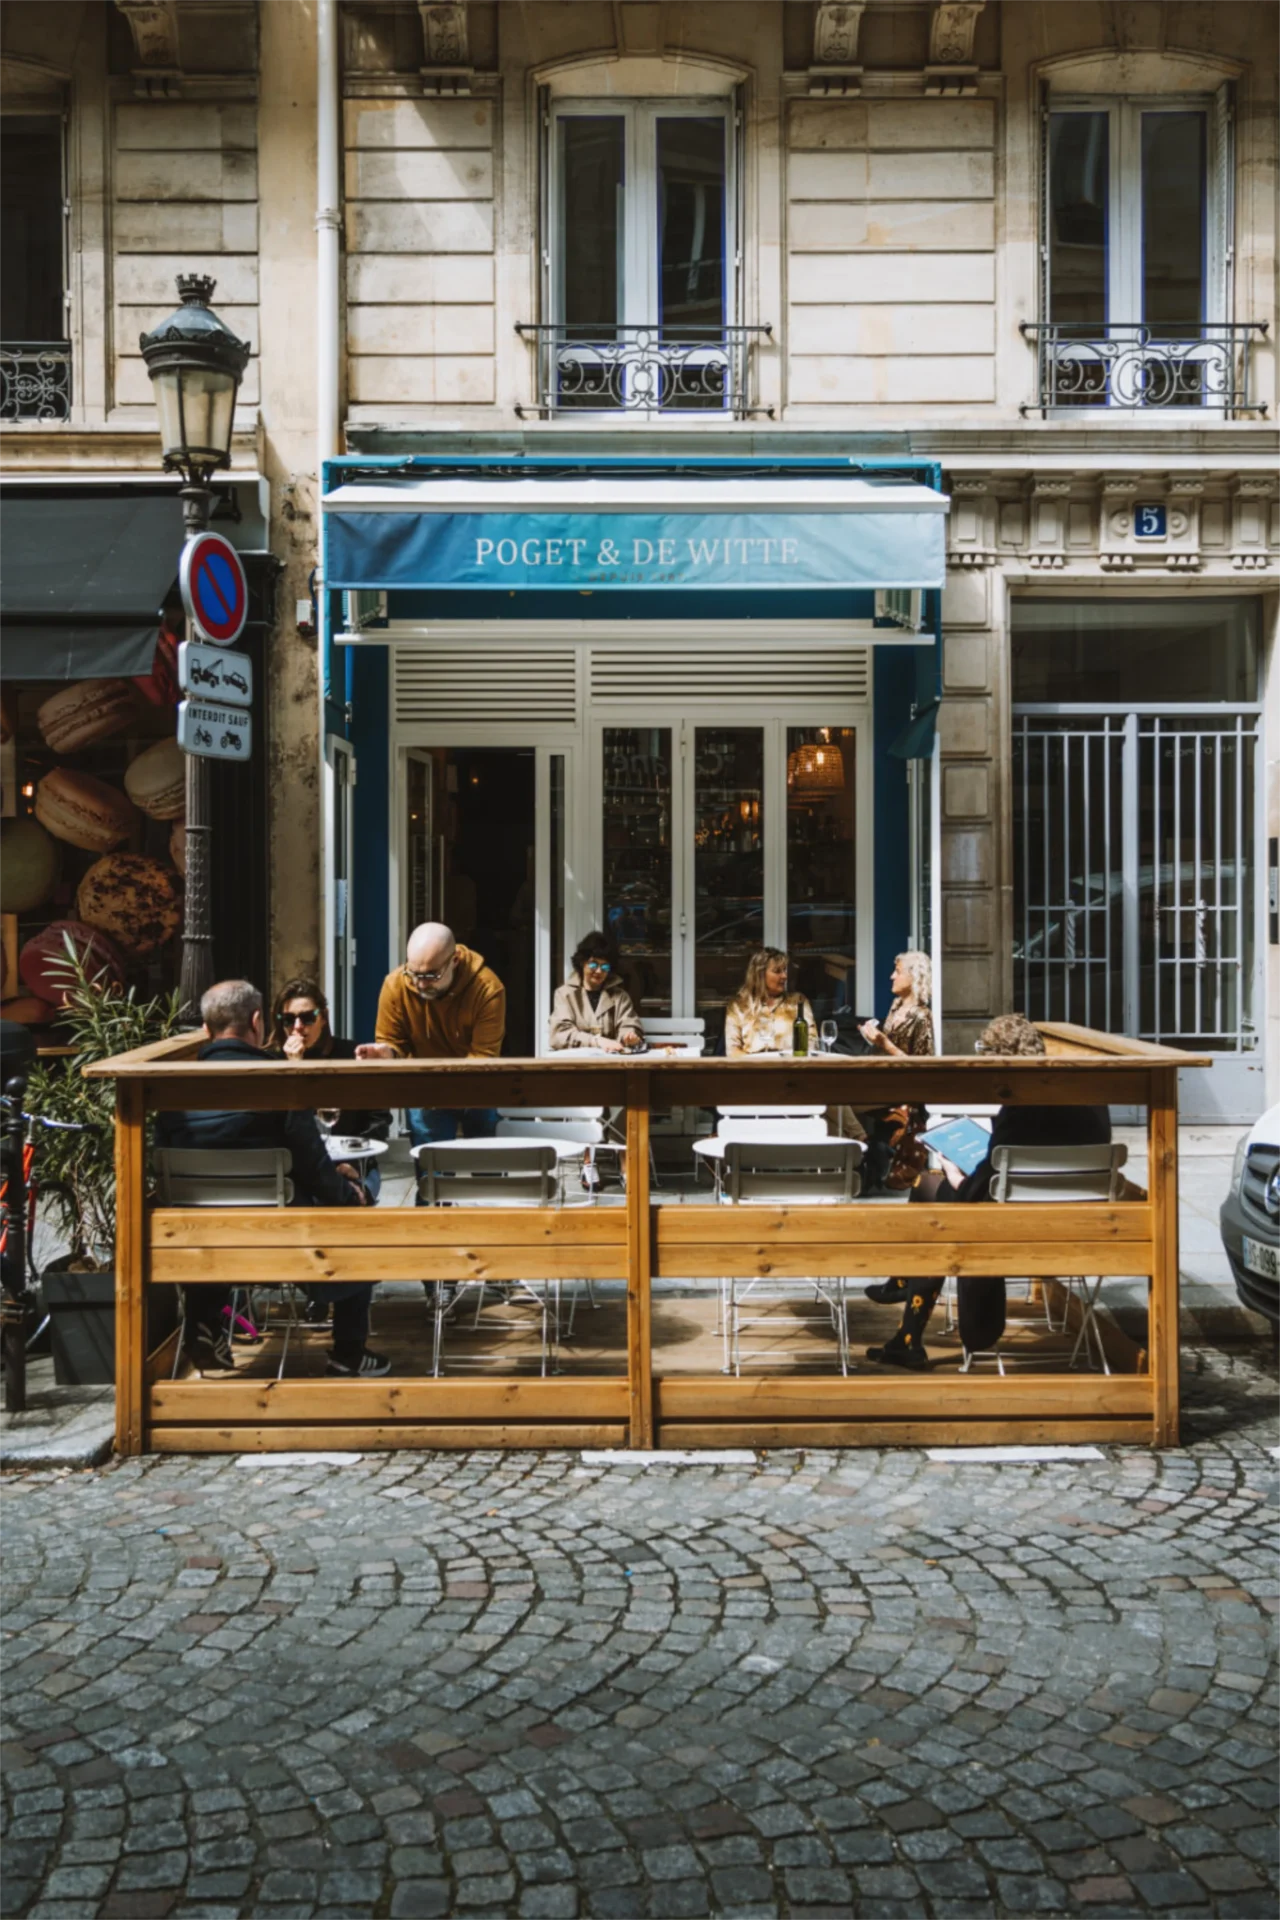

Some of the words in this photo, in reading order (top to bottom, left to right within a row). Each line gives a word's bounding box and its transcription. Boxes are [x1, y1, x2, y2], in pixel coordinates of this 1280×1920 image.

[1142, 507, 1159, 534] 5
[475, 539, 586, 566] POGET
[597, 539, 620, 566] &
[632, 539, 676, 566] DE
[687, 539, 799, 566] WITTE
[189, 708, 226, 724] INTERDIT
[228, 714, 249, 728] SAUF
